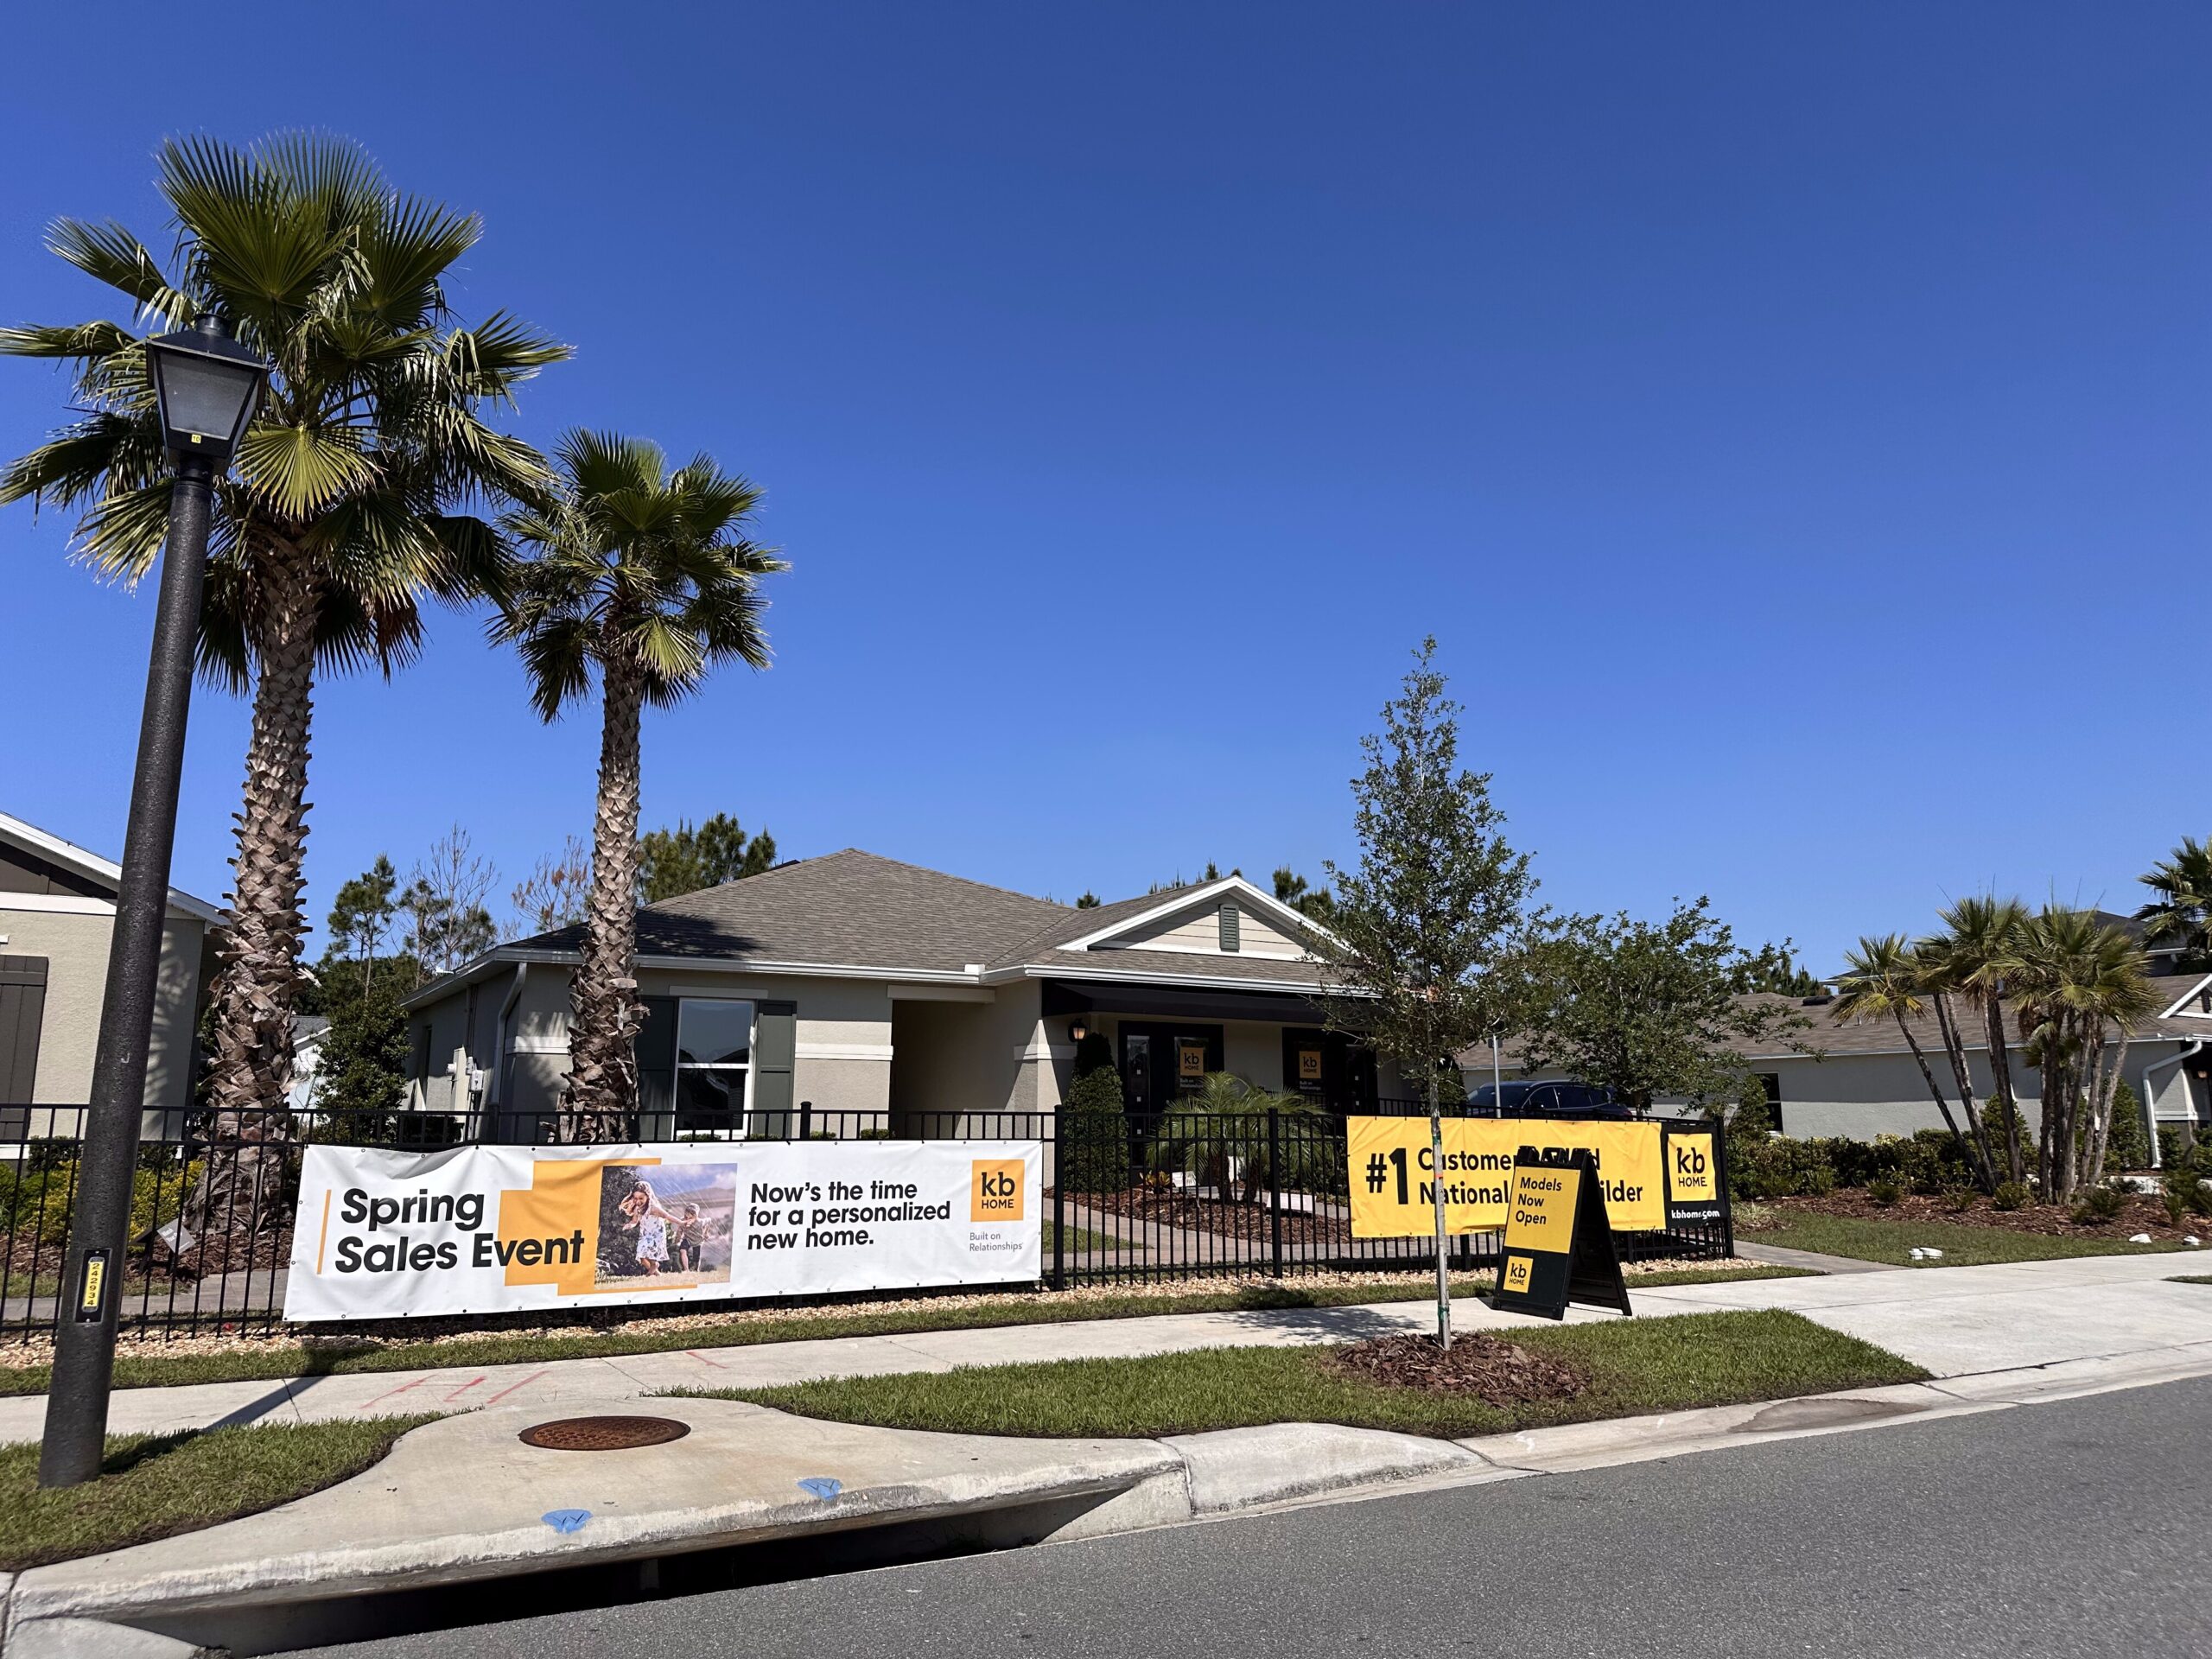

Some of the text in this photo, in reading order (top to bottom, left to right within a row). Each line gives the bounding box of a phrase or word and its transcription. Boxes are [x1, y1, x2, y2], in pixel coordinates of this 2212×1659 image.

[1184, 1052, 1199, 1065] kb
[1302, 1056, 1318, 1068] kb
[1676, 1147, 1706, 1174] kb
[981, 1171, 1015, 1197] kb
[1365, 1147, 1408, 1205] #1
[1520, 1176, 1562, 1192] Models
[1678, 1176, 1708, 1187] HOME
[751, 1180, 918, 1204] Now's the time
[1517, 1193, 1545, 1207] Now
[340, 1188, 485, 1232] Spring
[981, 1198, 1014, 1210] HOME
[748, 1201, 950, 1230] for a personalized
[1515, 1210, 1547, 1227] Open
[747, 1227, 874, 1250] new home.
[969, 1231, 988, 1241] Built
[334, 1230, 585, 1274] Sales Event
[1510, 1262, 1527, 1279] kb
[87, 1262, 100, 1306] 242934
